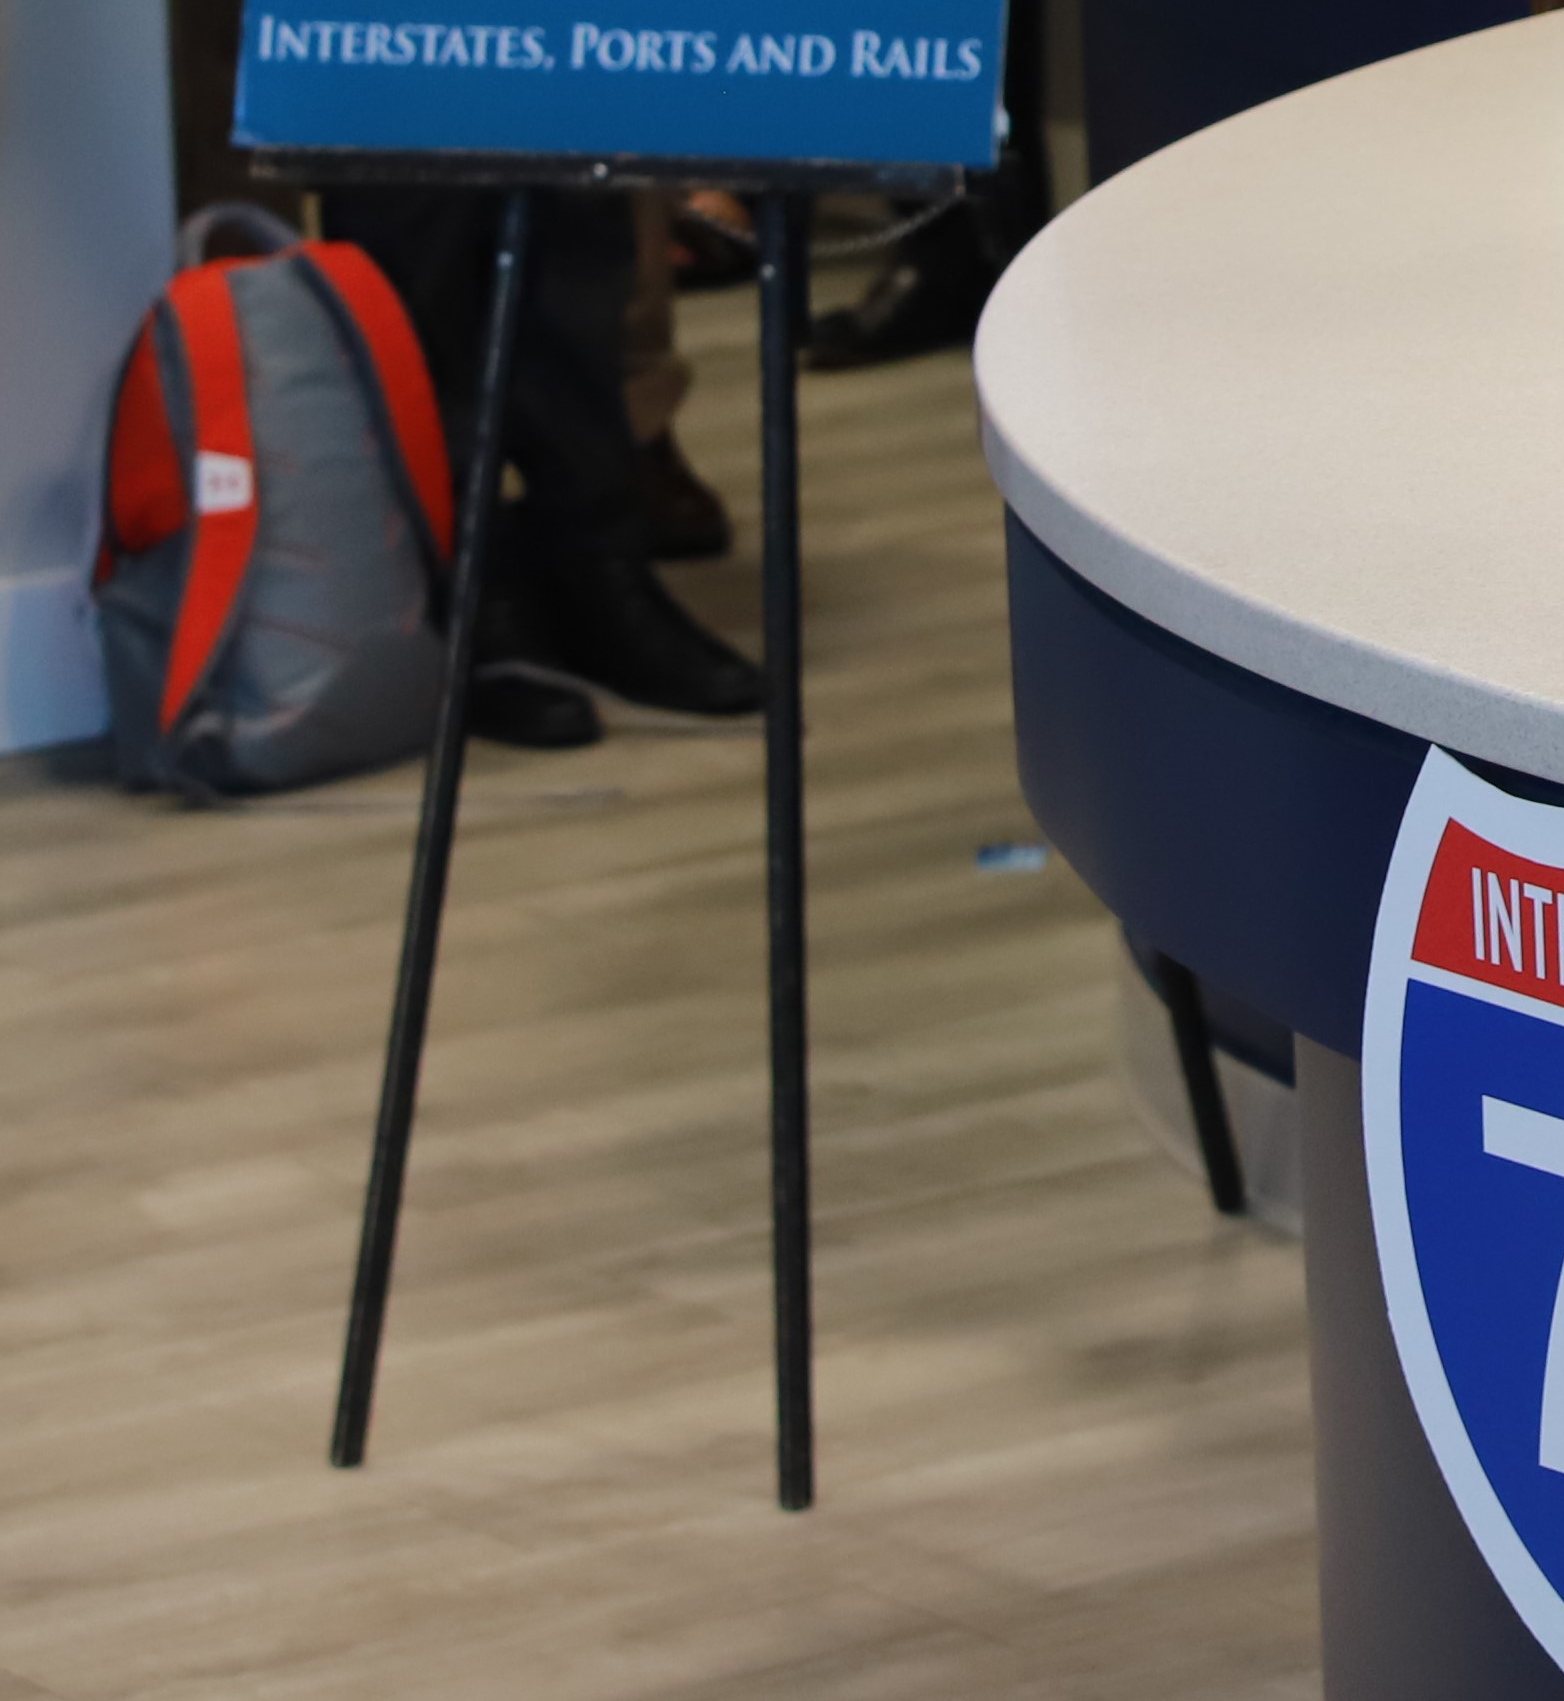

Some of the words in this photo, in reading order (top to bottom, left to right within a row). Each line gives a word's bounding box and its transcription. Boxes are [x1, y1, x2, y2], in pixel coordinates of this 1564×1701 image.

[258, 14, 555, 73] INTERSTATES,
[570, 23, 718, 74] PORTS
[726, 34, 836, 77] AND
[851, 29, 983, 81] RAILS
